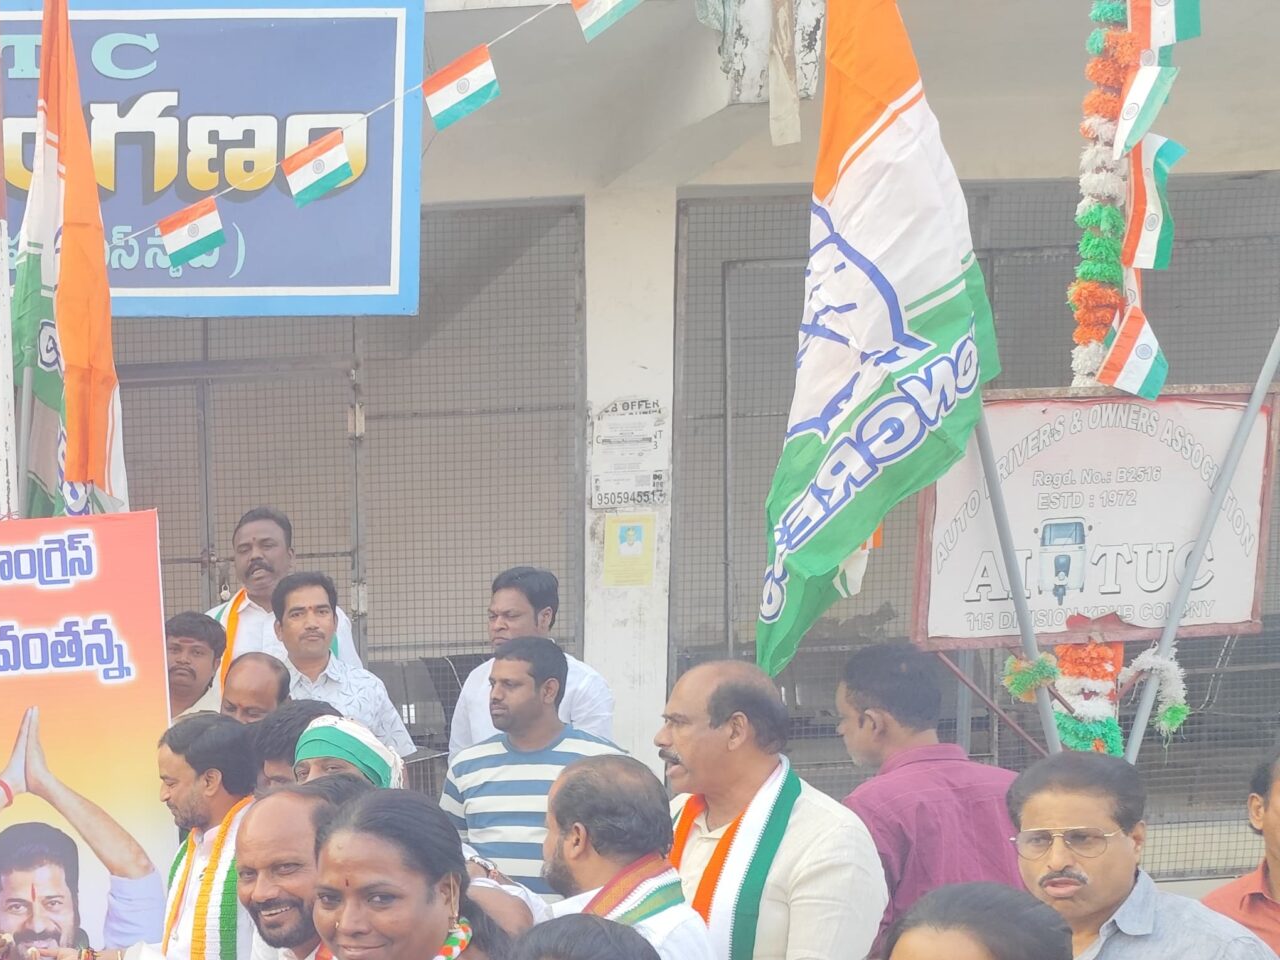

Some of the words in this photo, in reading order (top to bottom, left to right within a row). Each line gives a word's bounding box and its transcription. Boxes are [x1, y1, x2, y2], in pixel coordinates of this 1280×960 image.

[934, 489, 981, 575] AUTO
[1088, 402, 1160, 438] OWNERS
[1160, 418, 1256, 558] ASSOCITION
[1032, 469, 1077, 489] Regd.
[1116, 466, 1162, 483] B2516
[1037, 492, 1084, 510] ESTD
[1099, 490, 1137, 508] 1972
[999, 605, 1078, 629] DIISION
[1138, 599, 1216, 621] COLNY
